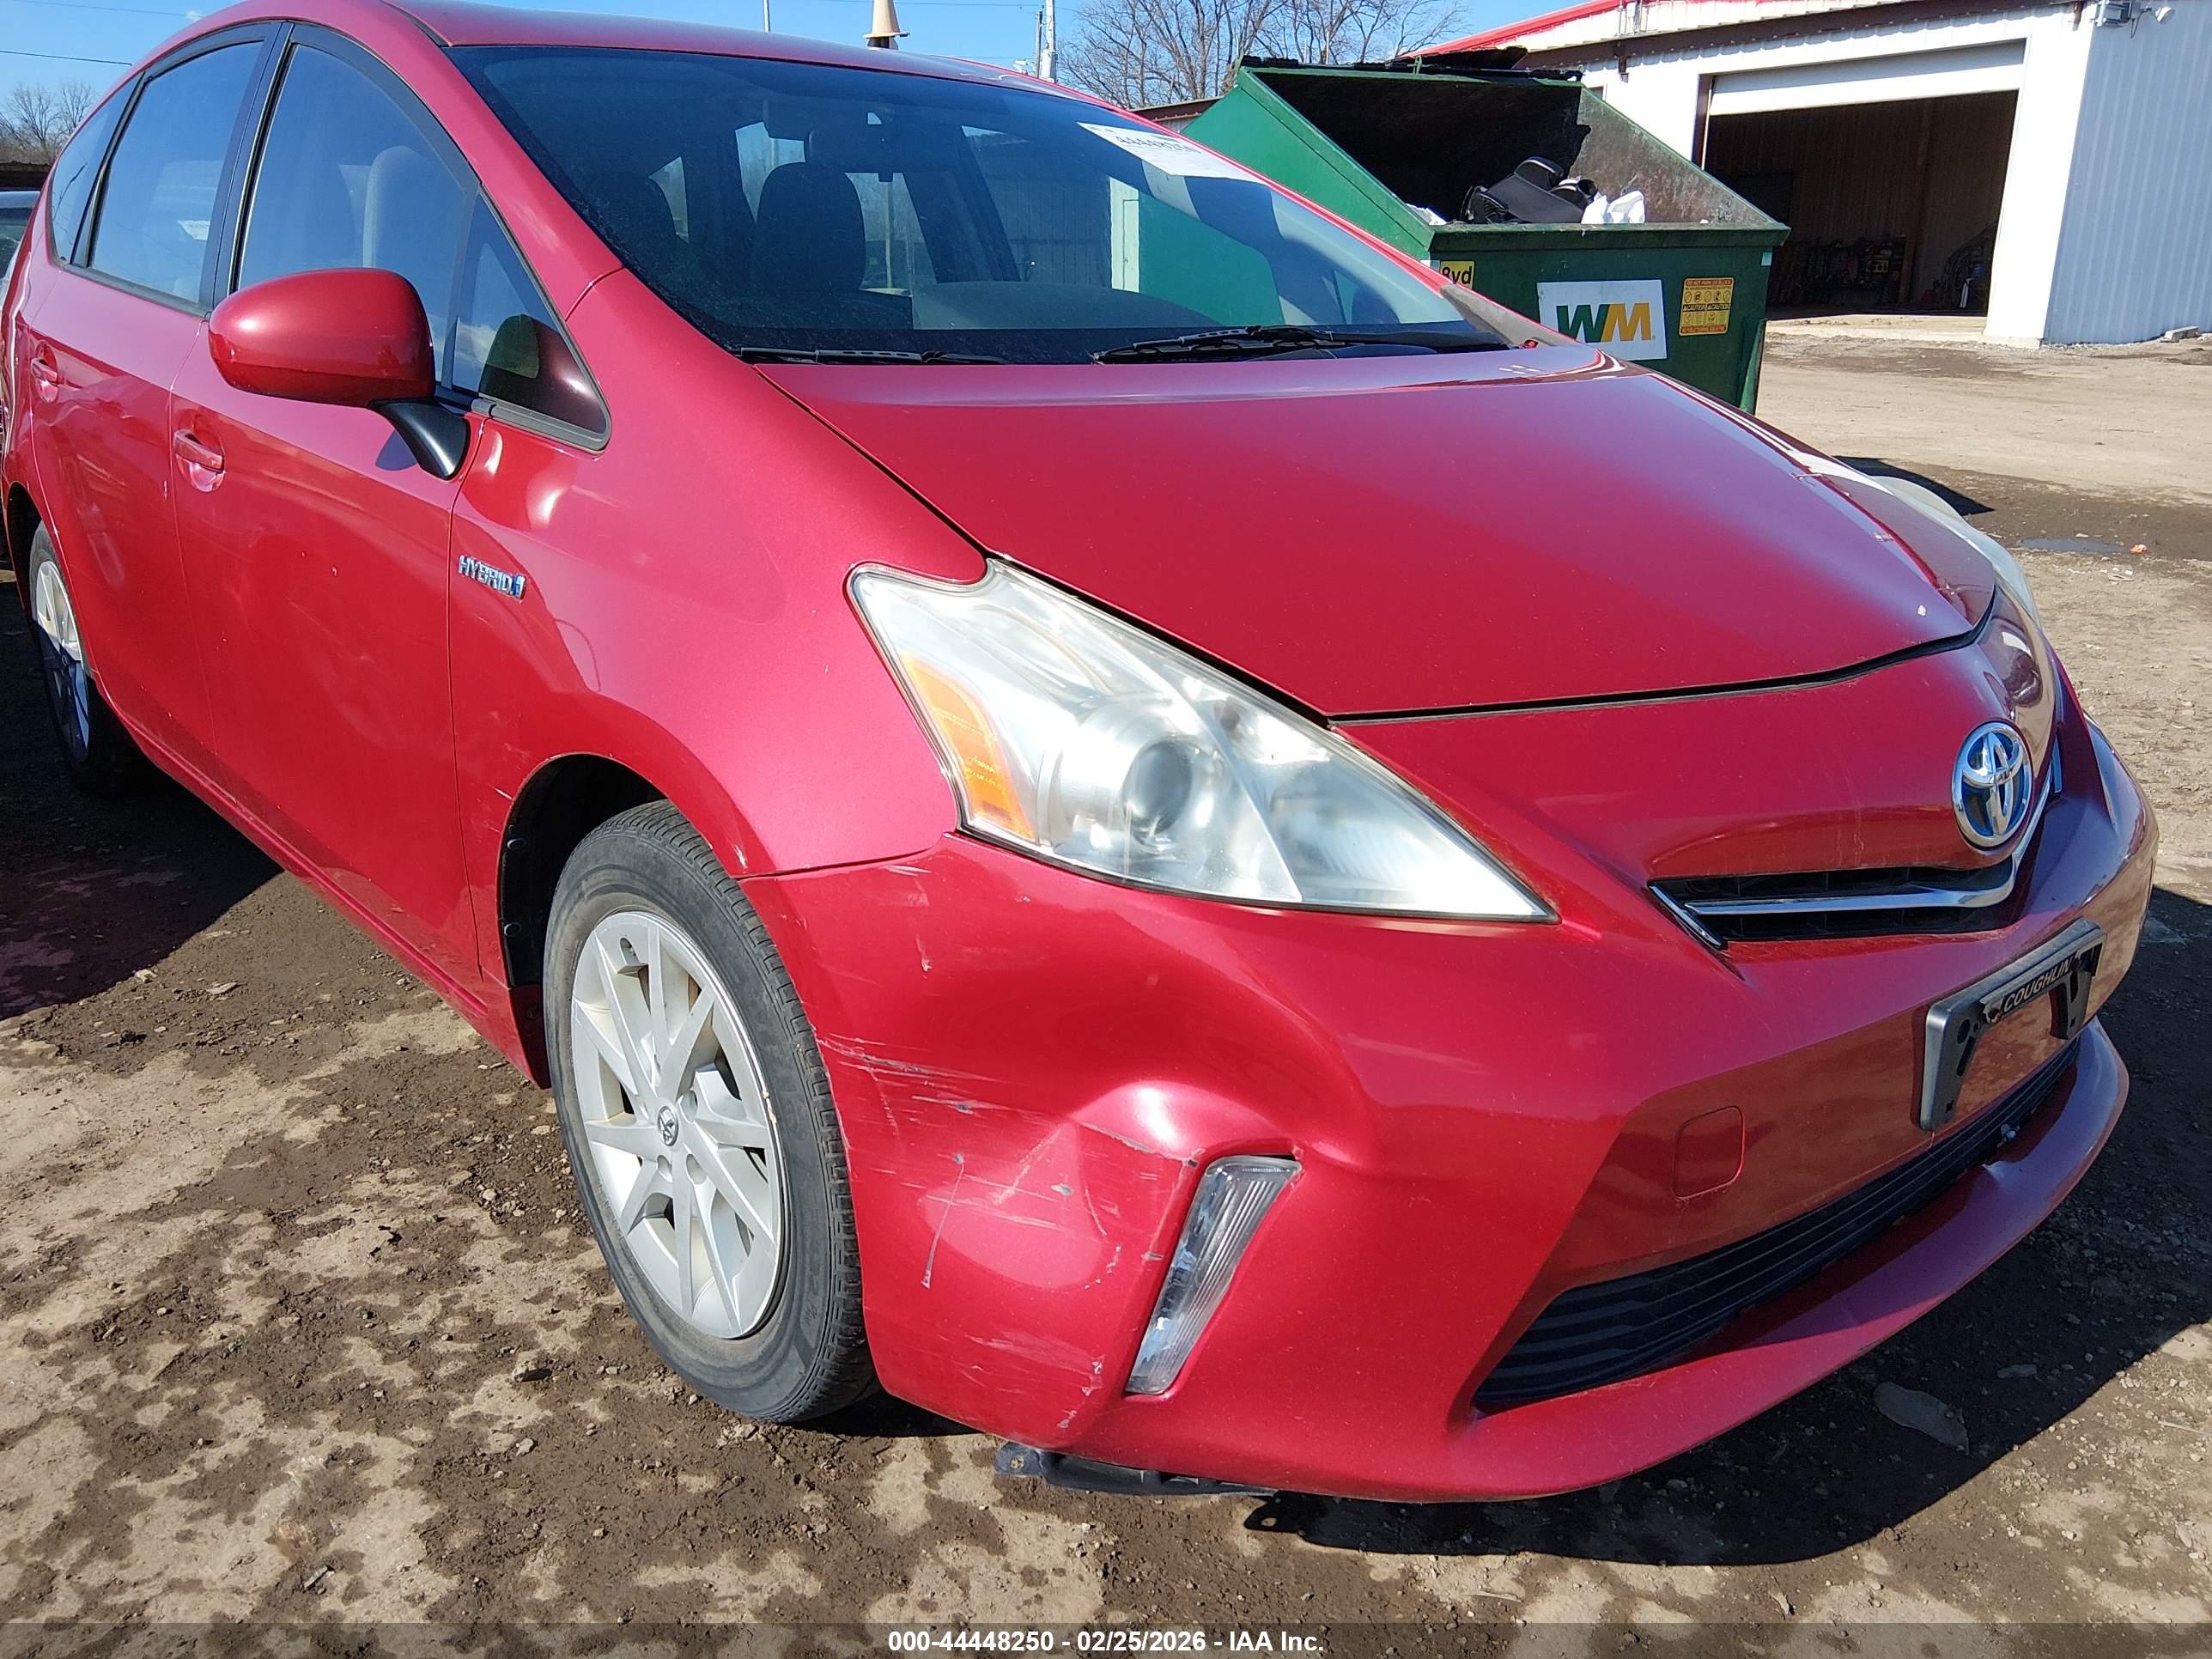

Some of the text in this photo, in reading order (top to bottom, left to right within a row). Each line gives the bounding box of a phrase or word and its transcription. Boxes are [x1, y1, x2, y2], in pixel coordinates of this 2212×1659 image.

[1556, 302, 1651, 343] WM
[458, 555, 513, 592] HYBRID
[2003, 956, 2074, 1012] COUGHLIN
